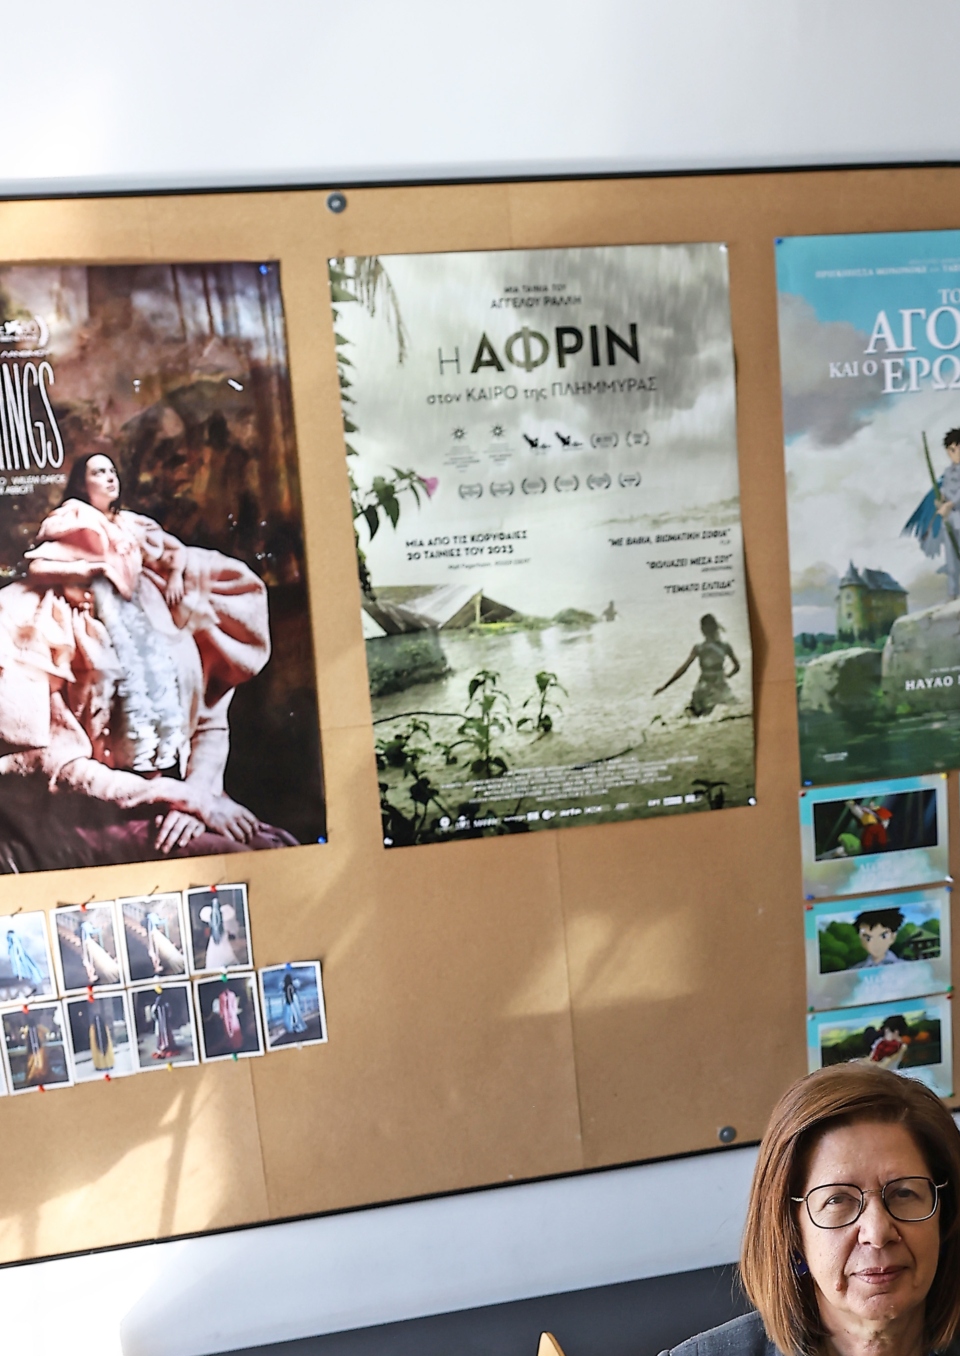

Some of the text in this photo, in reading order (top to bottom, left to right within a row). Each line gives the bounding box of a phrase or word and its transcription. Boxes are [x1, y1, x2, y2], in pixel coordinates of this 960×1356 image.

[438, 322, 641, 376] Η ΑΦΡΙΝ
[829, 361, 859, 379] ΚΑΙ
[862, 359, 878, 377] Ο
[466, 385, 518, 403] ΚΑΙΡΟ
[551, 376, 658, 397] ΠΛΗΜΜΥΡΑΣ
